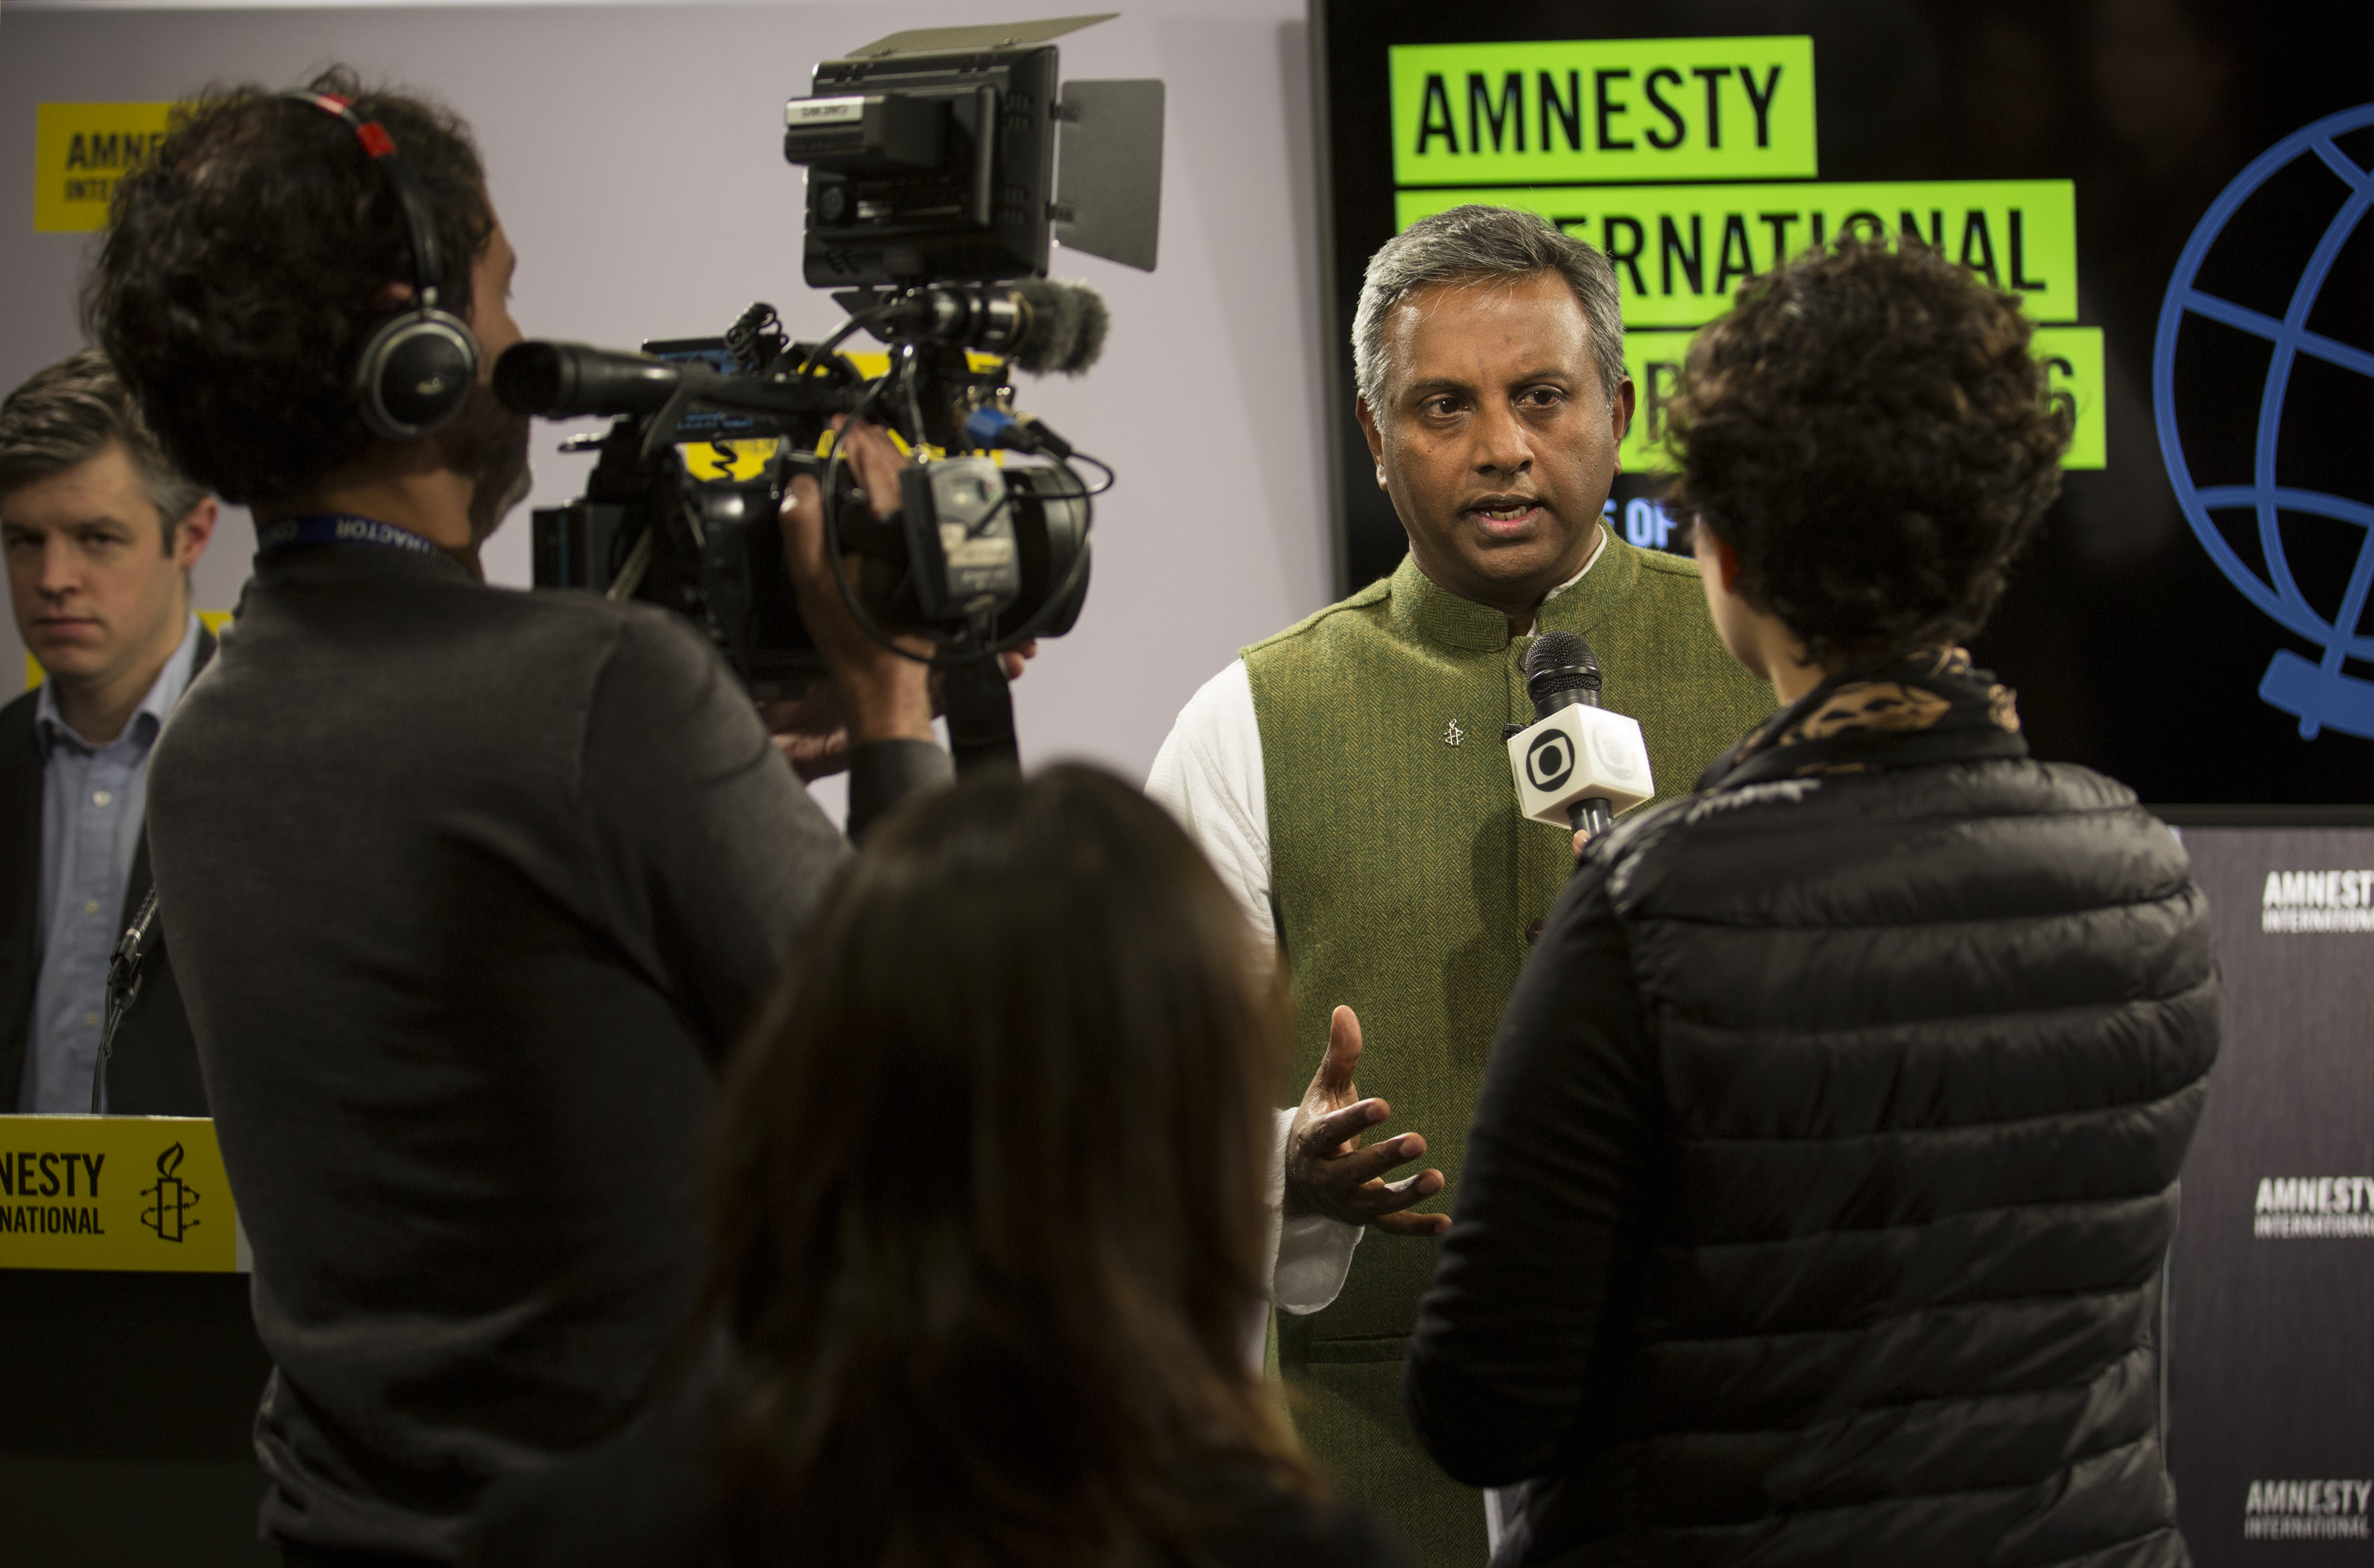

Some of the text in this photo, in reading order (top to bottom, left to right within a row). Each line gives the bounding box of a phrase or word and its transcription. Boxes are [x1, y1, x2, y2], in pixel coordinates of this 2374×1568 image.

[1415, 64, 1783, 155] AMNESTY
[2262, 870, 2374, 907] AMNEST
[0, 1152, 105, 1197] NESTY
[0, 1205, 105, 1234] NATIONAL
[2246, 1478, 2374, 1515] AMNESTY
[2244, 1515, 2372, 1540] INTERNATIONAL
